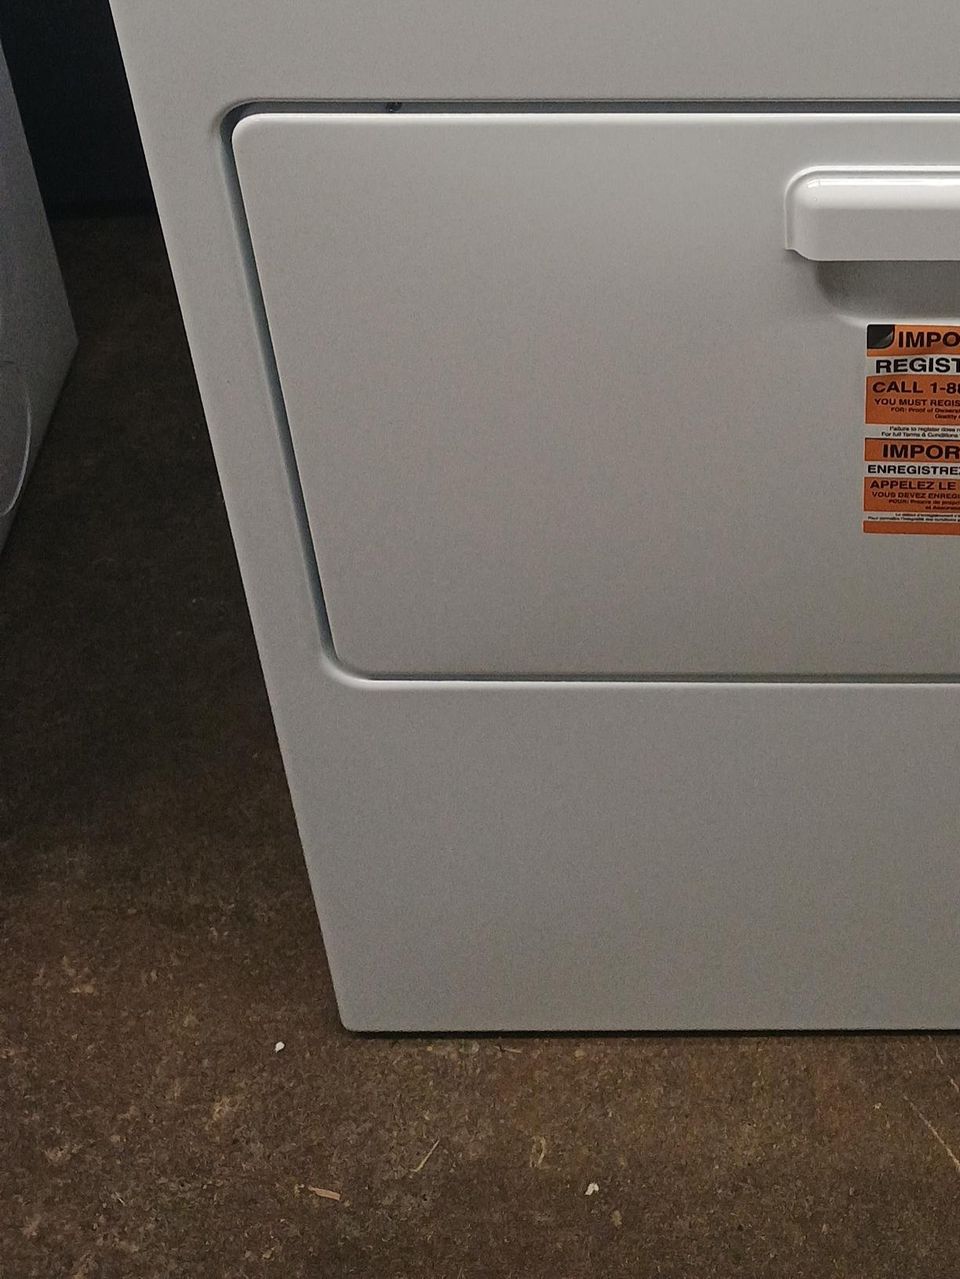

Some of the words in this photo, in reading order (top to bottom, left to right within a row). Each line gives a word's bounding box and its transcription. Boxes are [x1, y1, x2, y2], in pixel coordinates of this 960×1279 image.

[872, 380, 924, 394] CALL
[874, 397, 899, 406] YOU
[899, 398, 928, 407] MUST
[869, 479, 935, 490] APPELEZ
[938, 481, 956, 491] LE
[871, 491, 898, 499] VOUS
[898, 492, 926, 500] DEVEZ
